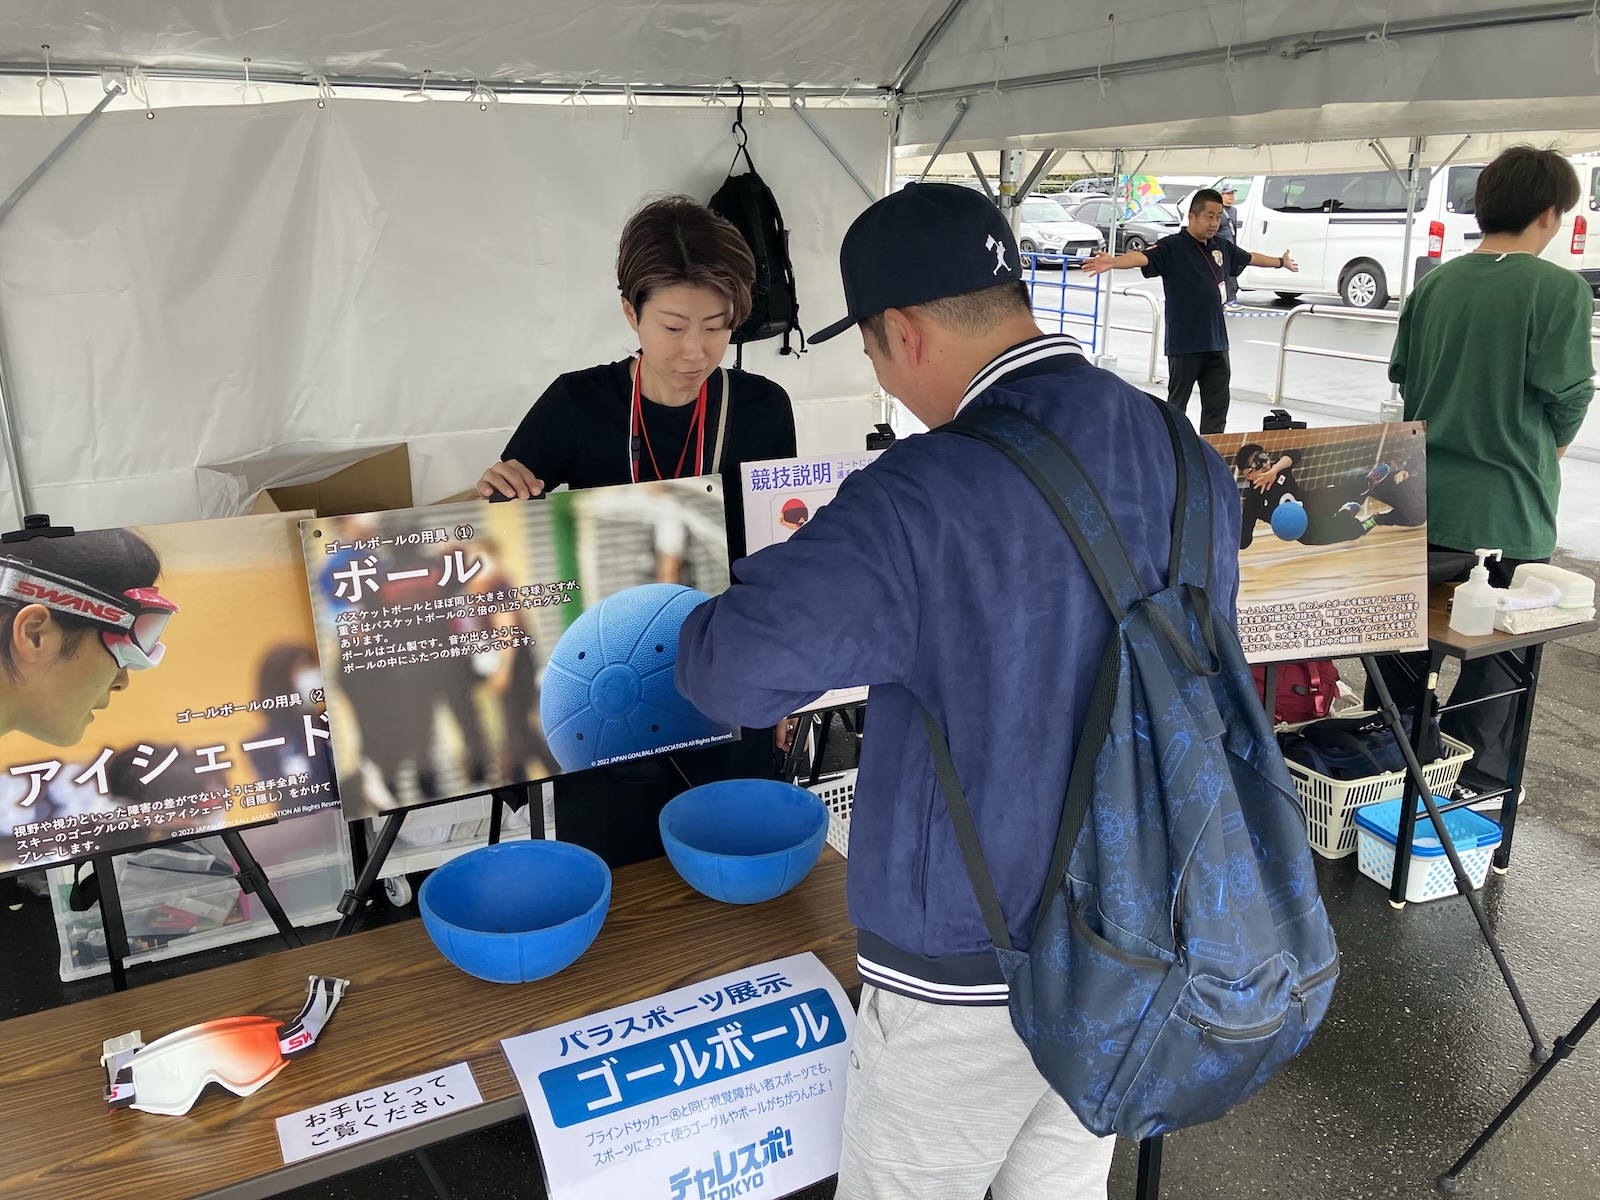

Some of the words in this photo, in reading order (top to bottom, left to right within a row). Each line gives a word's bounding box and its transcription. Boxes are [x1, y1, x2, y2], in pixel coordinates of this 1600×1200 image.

[750, 462, 832, 492] 競技説明
[325, 524, 474, 554] ゴールボールの用具（1）
[333, 550, 482, 603] ボール
[15, 579, 126, 624] SWANS
[340, 633, 389, 649] あります。
[343, 635, 536, 674] ボールの中にふたつの鈴が入っています。
[177, 688, 325, 723] ゴールボールの用具（2
[10, 711, 330, 807] アイシェード
[597, 758, 609, 766] 2022
[610, 754, 627, 763] JAPAN
[627, 749, 654, 760] GOALBALL
[654, 741, 688, 754] ASSOCIATION
[695, 737, 710, 746] Rights
[13, 772, 309, 838] 視野や視力といった障害の差がでないように選手全員が
[16, 781, 331, 851] スキーのゴーグルのようなアイシェード（目隠し）をかけて
[178, 827, 194, 837] 2022
[195, 823, 216, 834] JAPAN
[218, 817, 249, 829] GOALBALL
[251, 808, 292, 822] ASSOCIATION
[293, 806, 301, 814] All
[302, 803, 320, 813] Rights
[321, 800, 341, 808] Reserv
[18, 840, 101, 865] プレーします。
[559, 972, 793, 1057] パラスポーツ展示
[577, 1001, 830, 1112] ゴールボール
[304, 1074, 448, 1129] お手にとって
[310, 1092, 456, 1147] ご覧ください
[593, 1080, 834, 1167] スポーツによって使うゴーグルやボールがちがうんだよ！
